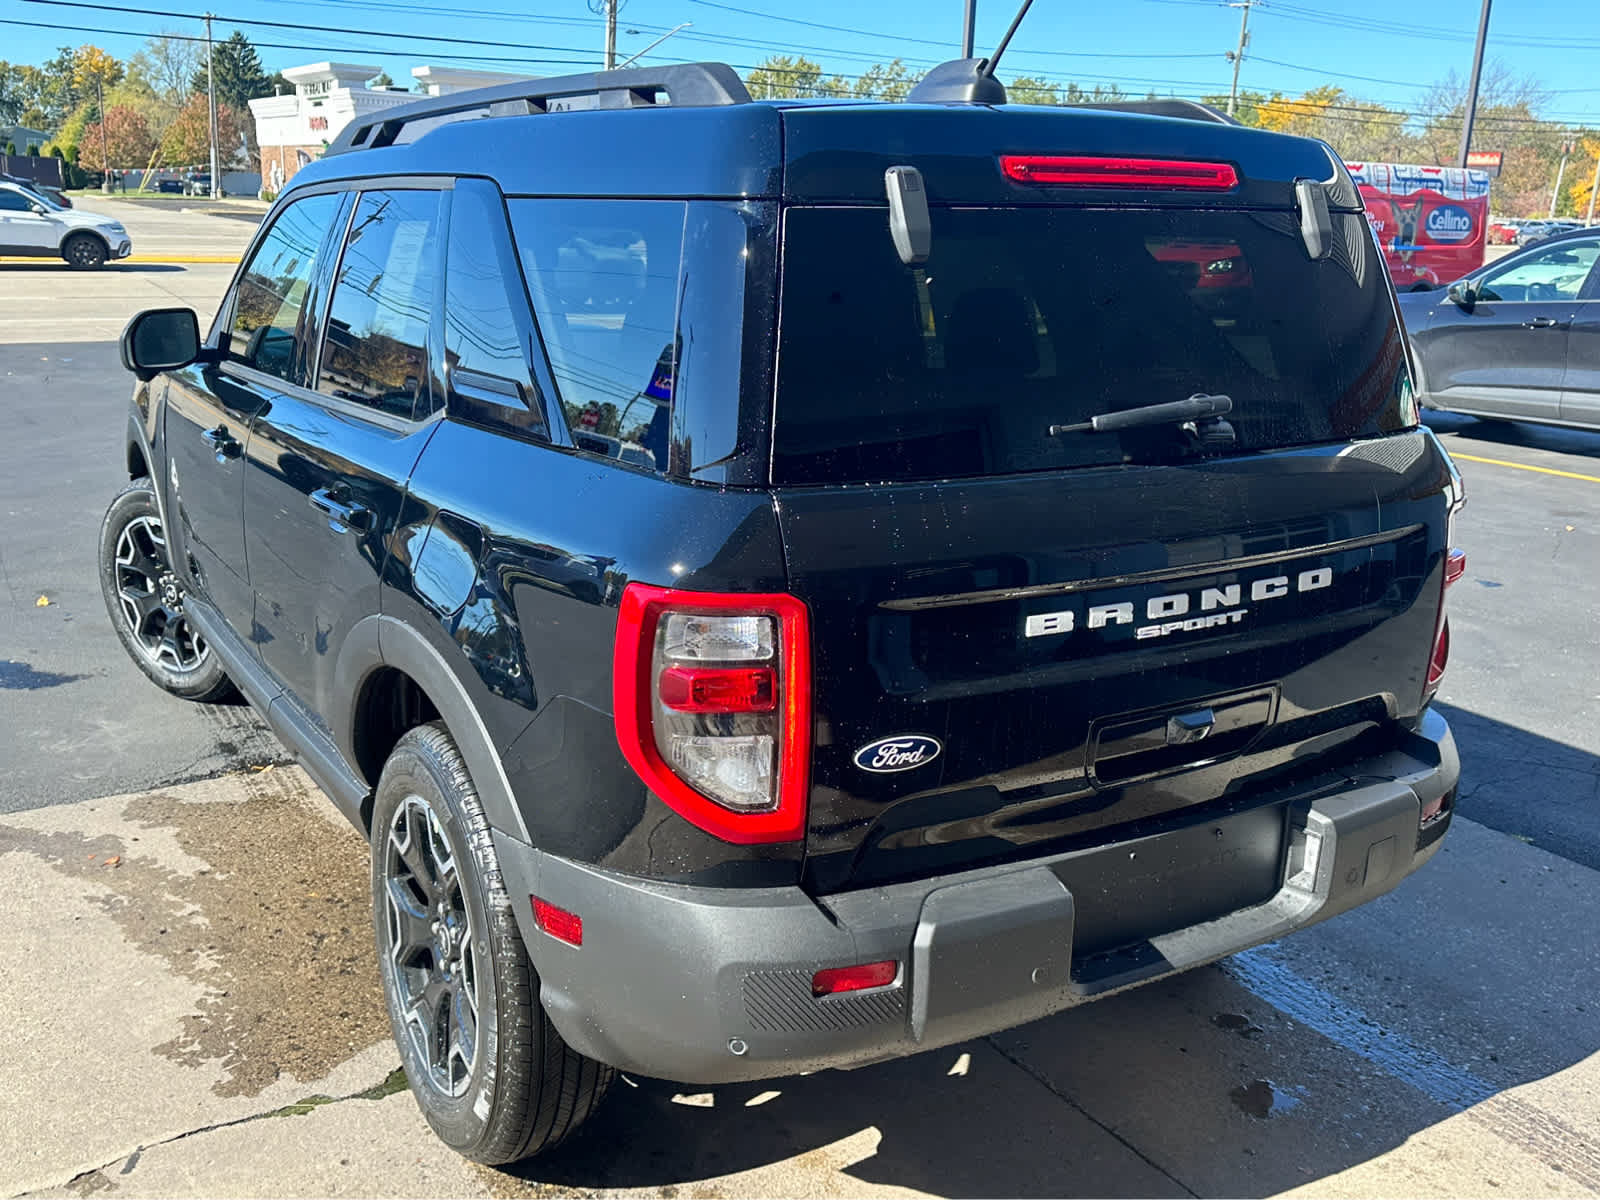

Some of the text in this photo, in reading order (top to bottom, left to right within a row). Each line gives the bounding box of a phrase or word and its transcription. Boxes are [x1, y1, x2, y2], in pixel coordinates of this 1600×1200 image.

[1368, 220, 1385, 232] SH
[1428, 209, 1470, 231] Cellino
[1025, 567, 1332, 638] BRONCO
[1136, 609, 1249, 640] SPORT
[872, 741, 926, 767] Ford
